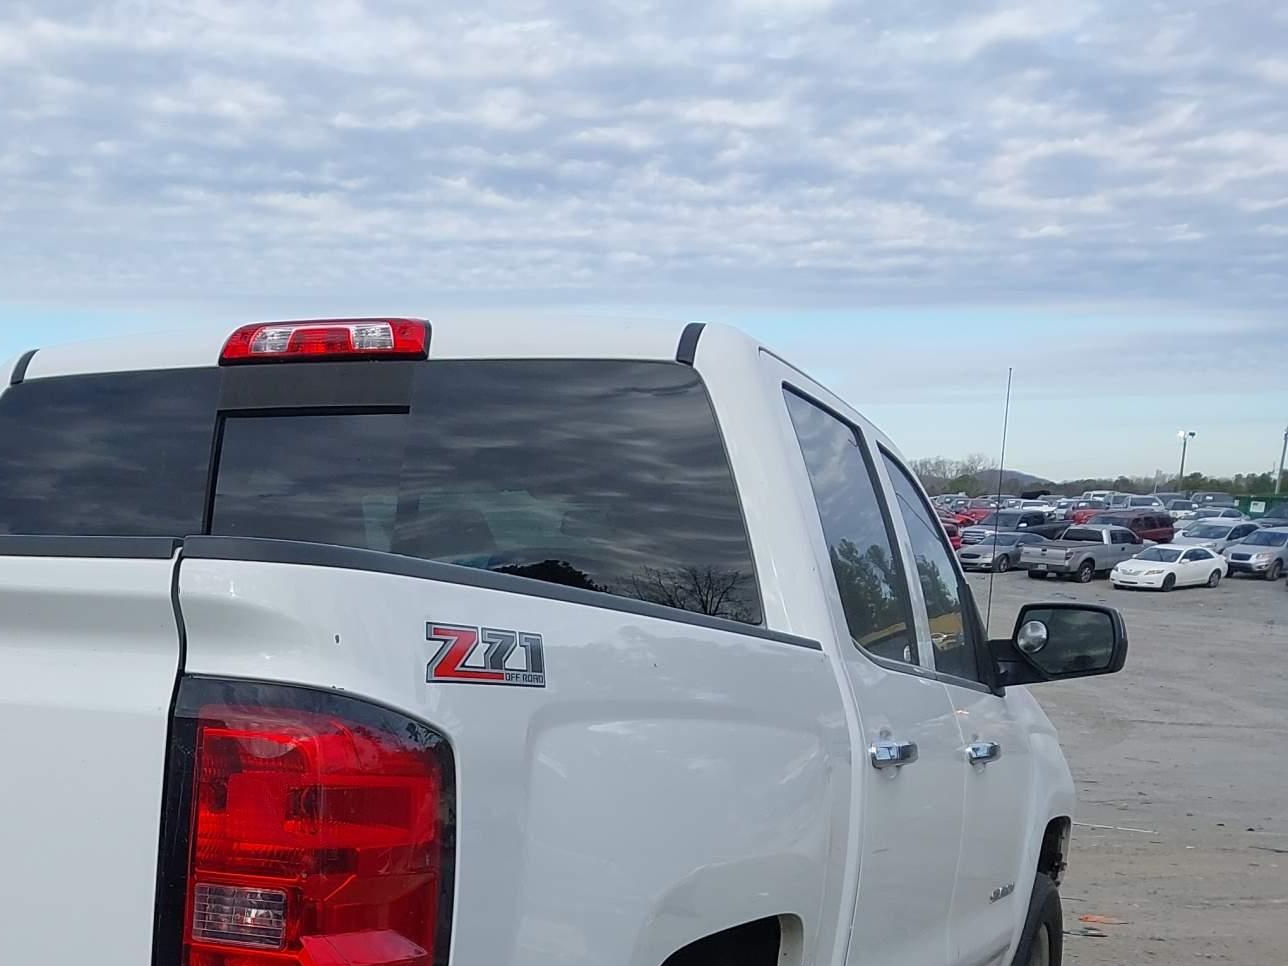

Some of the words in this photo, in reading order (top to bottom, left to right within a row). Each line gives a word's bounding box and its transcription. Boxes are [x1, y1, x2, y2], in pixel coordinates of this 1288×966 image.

[425, 621, 546, 688] Z71
[505, 673, 521, 682] OFF
[522, 674, 544, 684] ROAD
